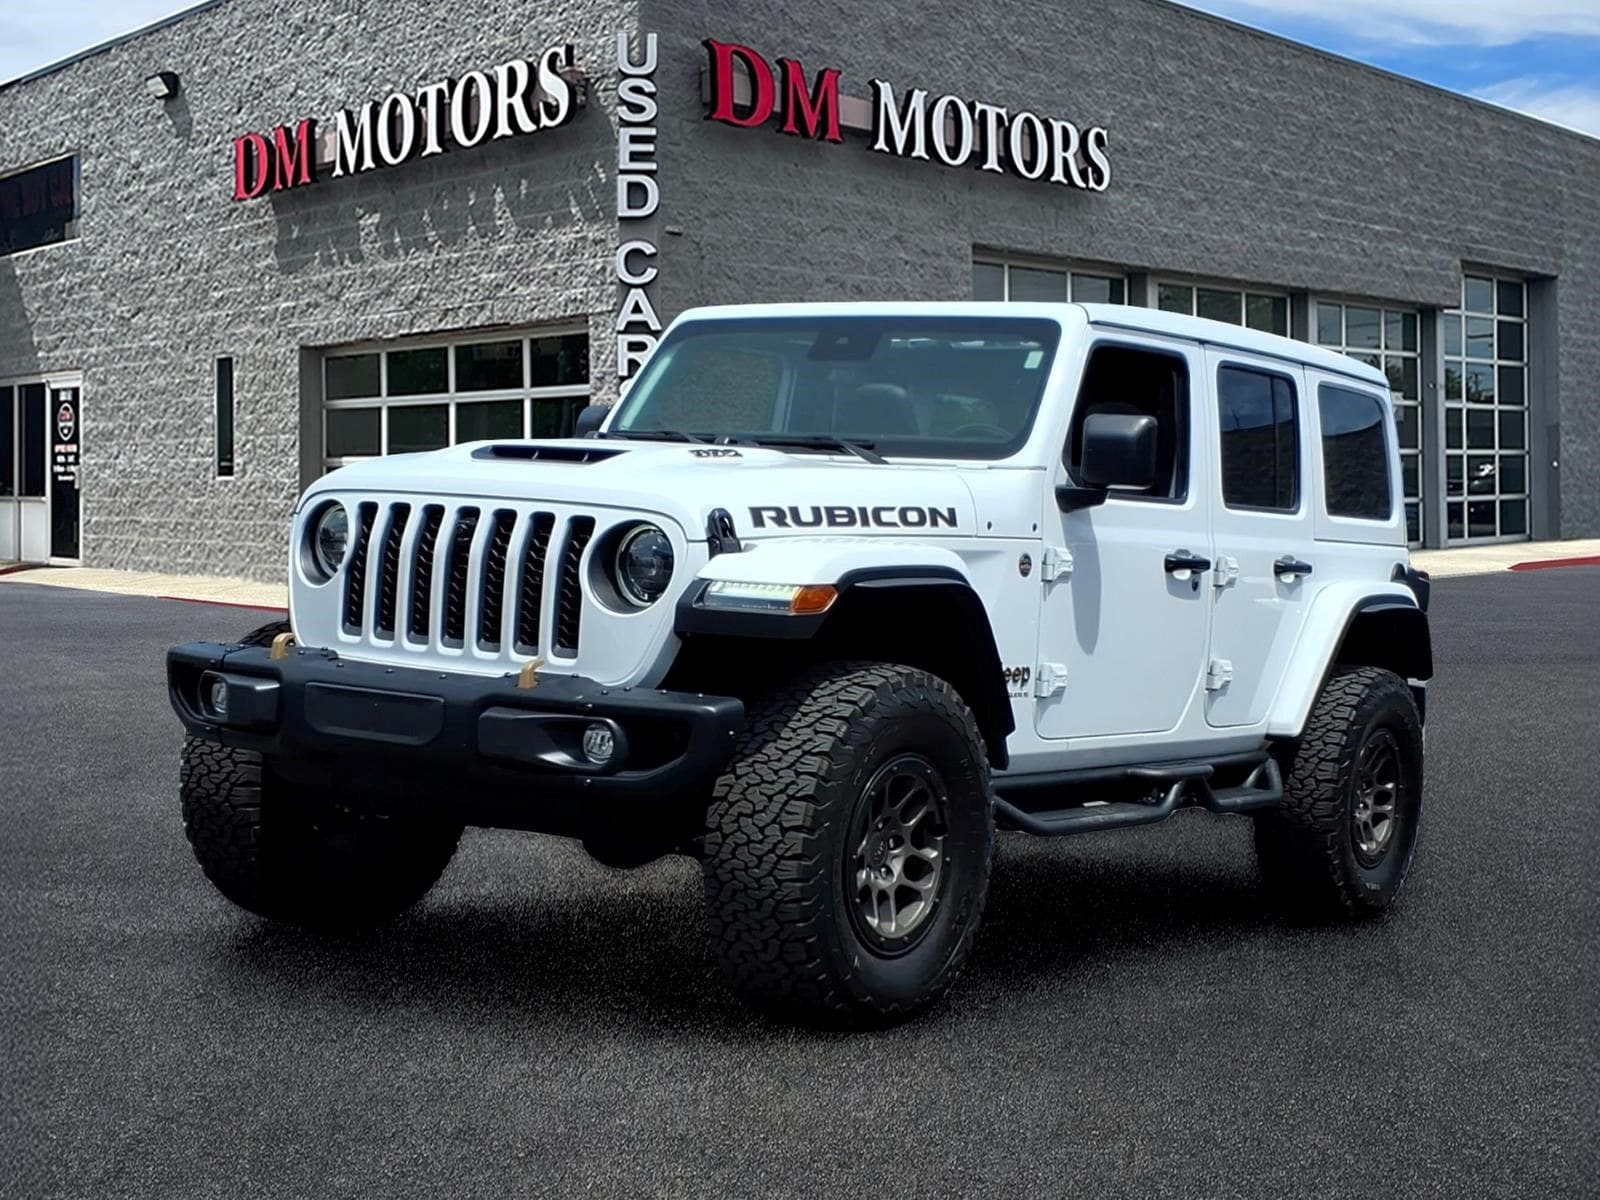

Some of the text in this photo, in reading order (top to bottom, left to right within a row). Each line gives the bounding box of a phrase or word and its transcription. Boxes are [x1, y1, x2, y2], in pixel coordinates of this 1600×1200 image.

[232, 46, 573, 201] DM MOTORS
[616, 32, 659, 218] USED
[707, 39, 1111, 191] DM MOTORS
[616, 240, 661, 395] CAR
[750, 505, 958, 528] RUBICON
[1003, 666, 1030, 687] eep
